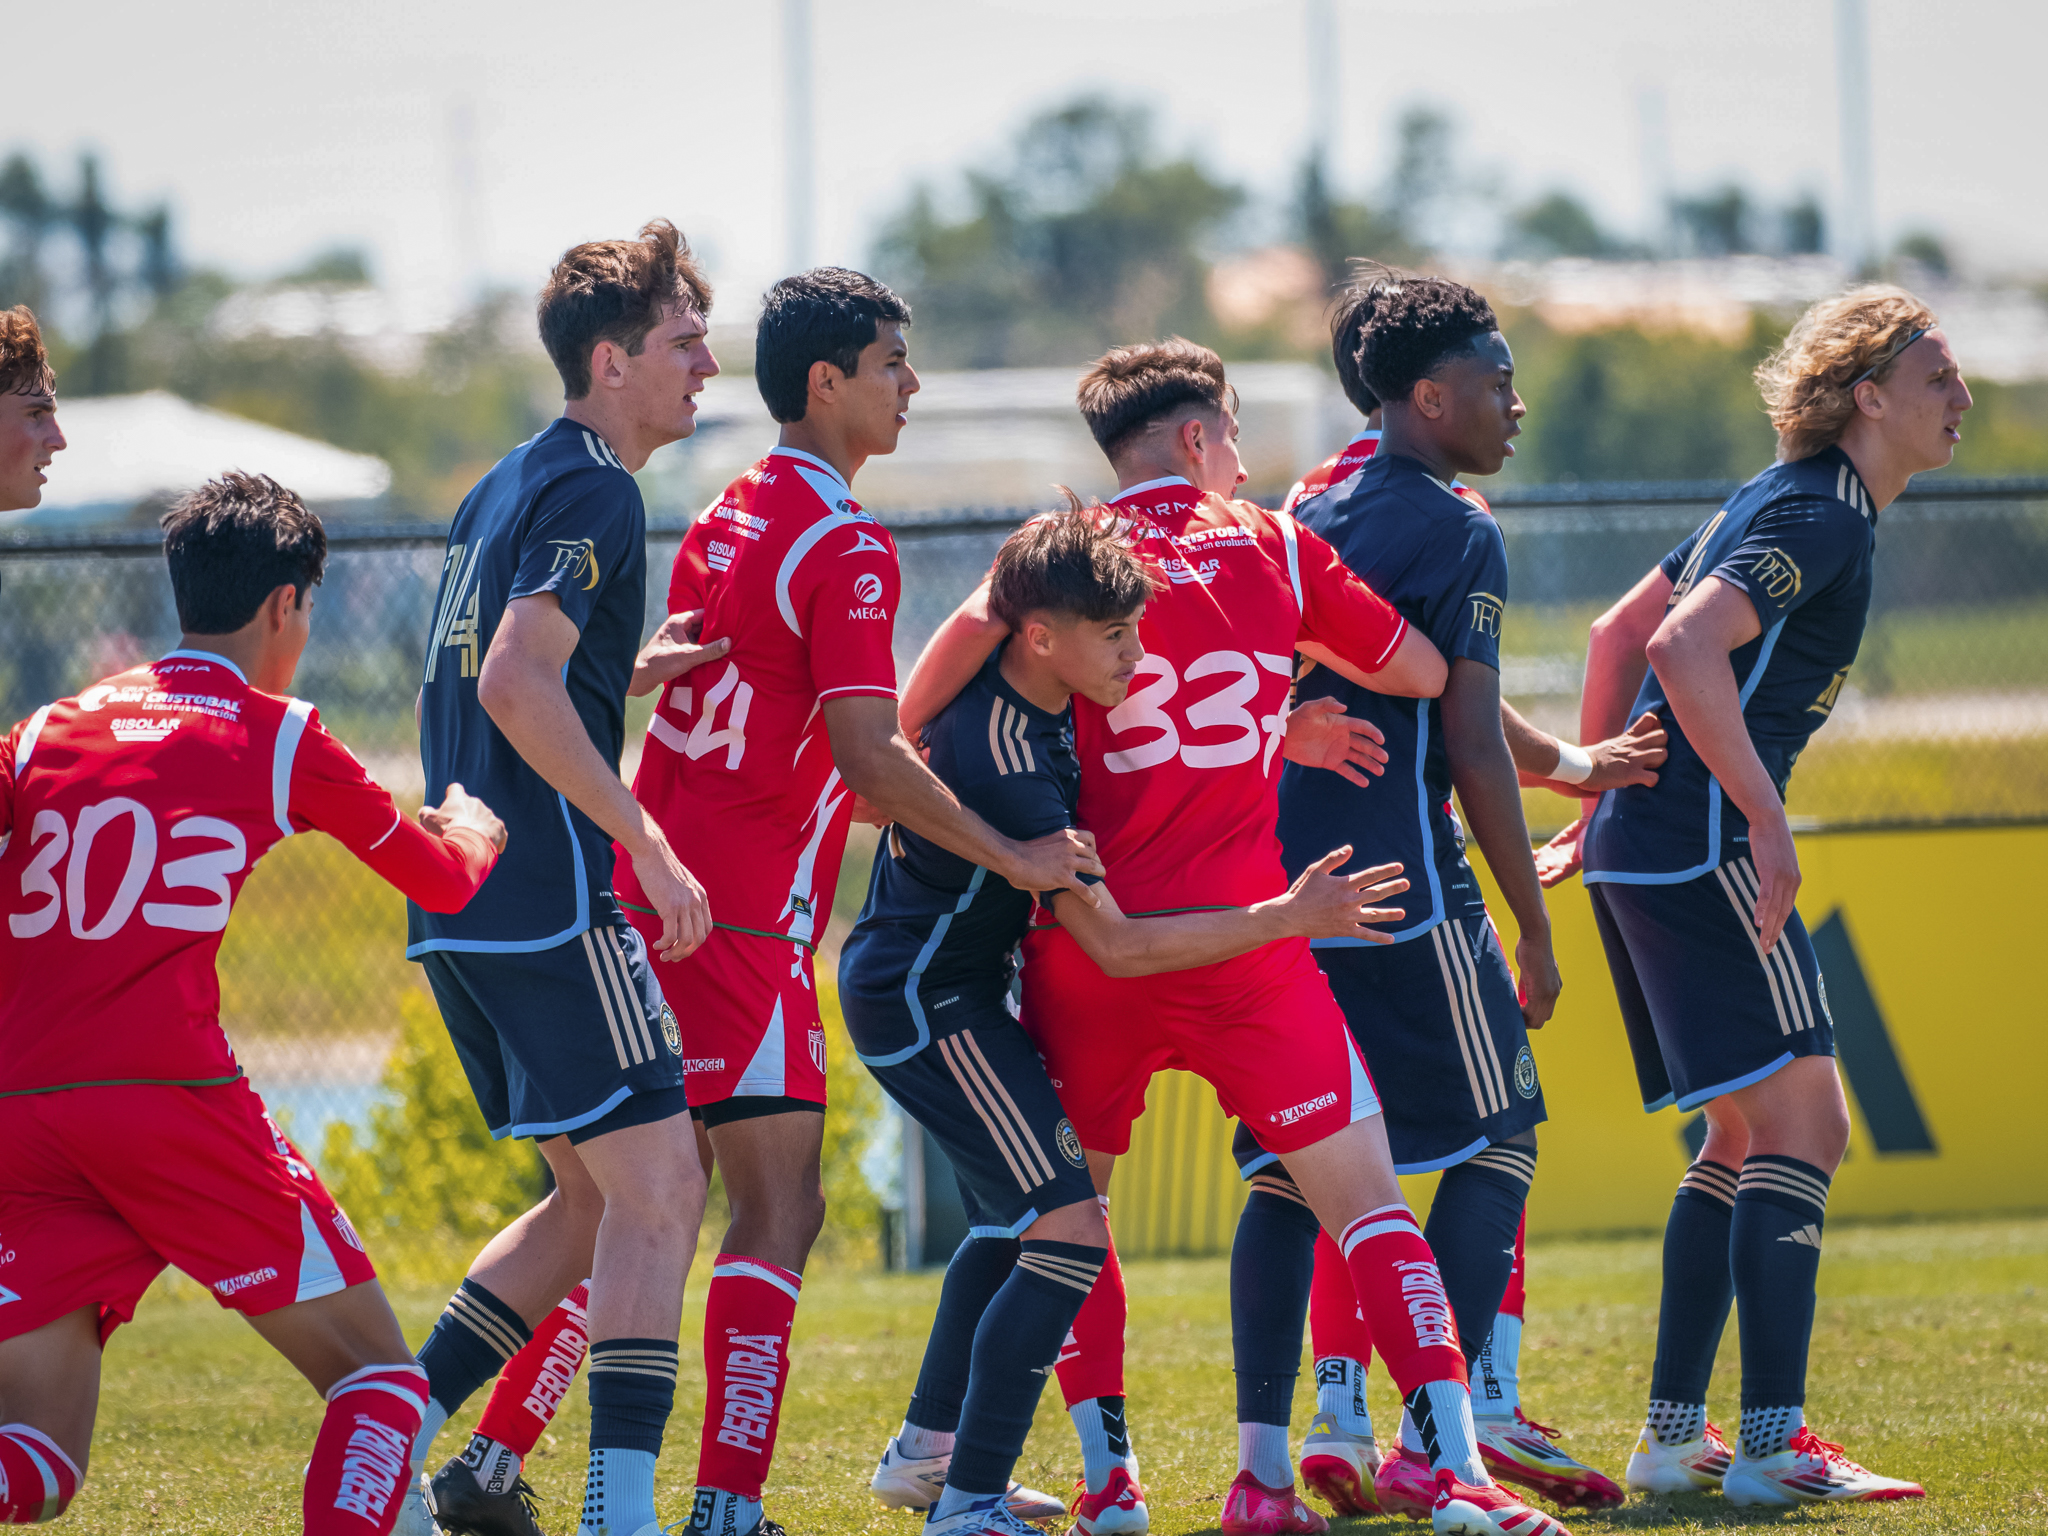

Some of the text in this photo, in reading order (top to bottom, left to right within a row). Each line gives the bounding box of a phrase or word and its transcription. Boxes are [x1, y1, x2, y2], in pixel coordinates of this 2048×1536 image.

[742, 468, 777, 485] PIRMA
[424, 536, 481, 684] 14
[848, 607, 887, 620] MEGA
[145, 692, 241, 713] CRISTOBAL
[110, 718, 181, 730] SISOLAR
[8, 797, 247, 940] 303
[682, 1059, 724, 1073] ANQGEL
[1488, 1383, 1501, 1399] FS
[1355, 1401, 1365, 1416] FS
